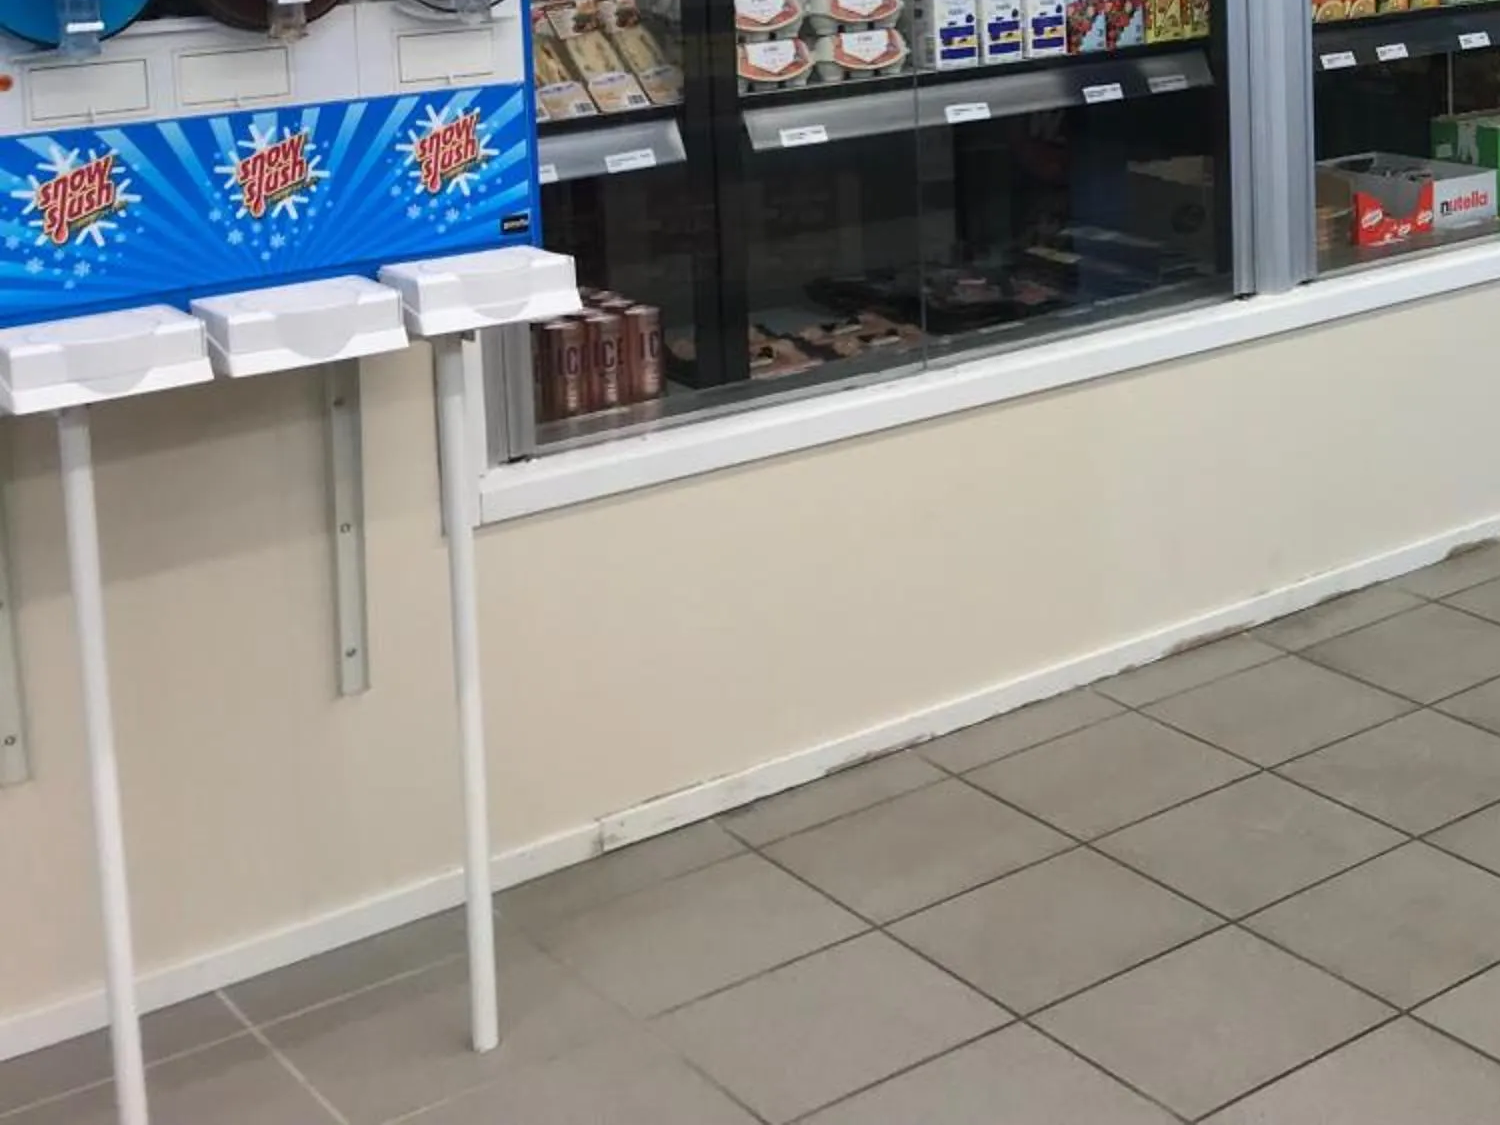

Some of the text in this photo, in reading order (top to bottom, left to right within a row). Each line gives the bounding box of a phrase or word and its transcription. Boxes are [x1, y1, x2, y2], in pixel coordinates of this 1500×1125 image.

[239, 133, 305, 181] snow
[418, 114, 477, 158] snow
[40, 155, 113, 206] snow
[1440, 190, 1489, 216] nutella
